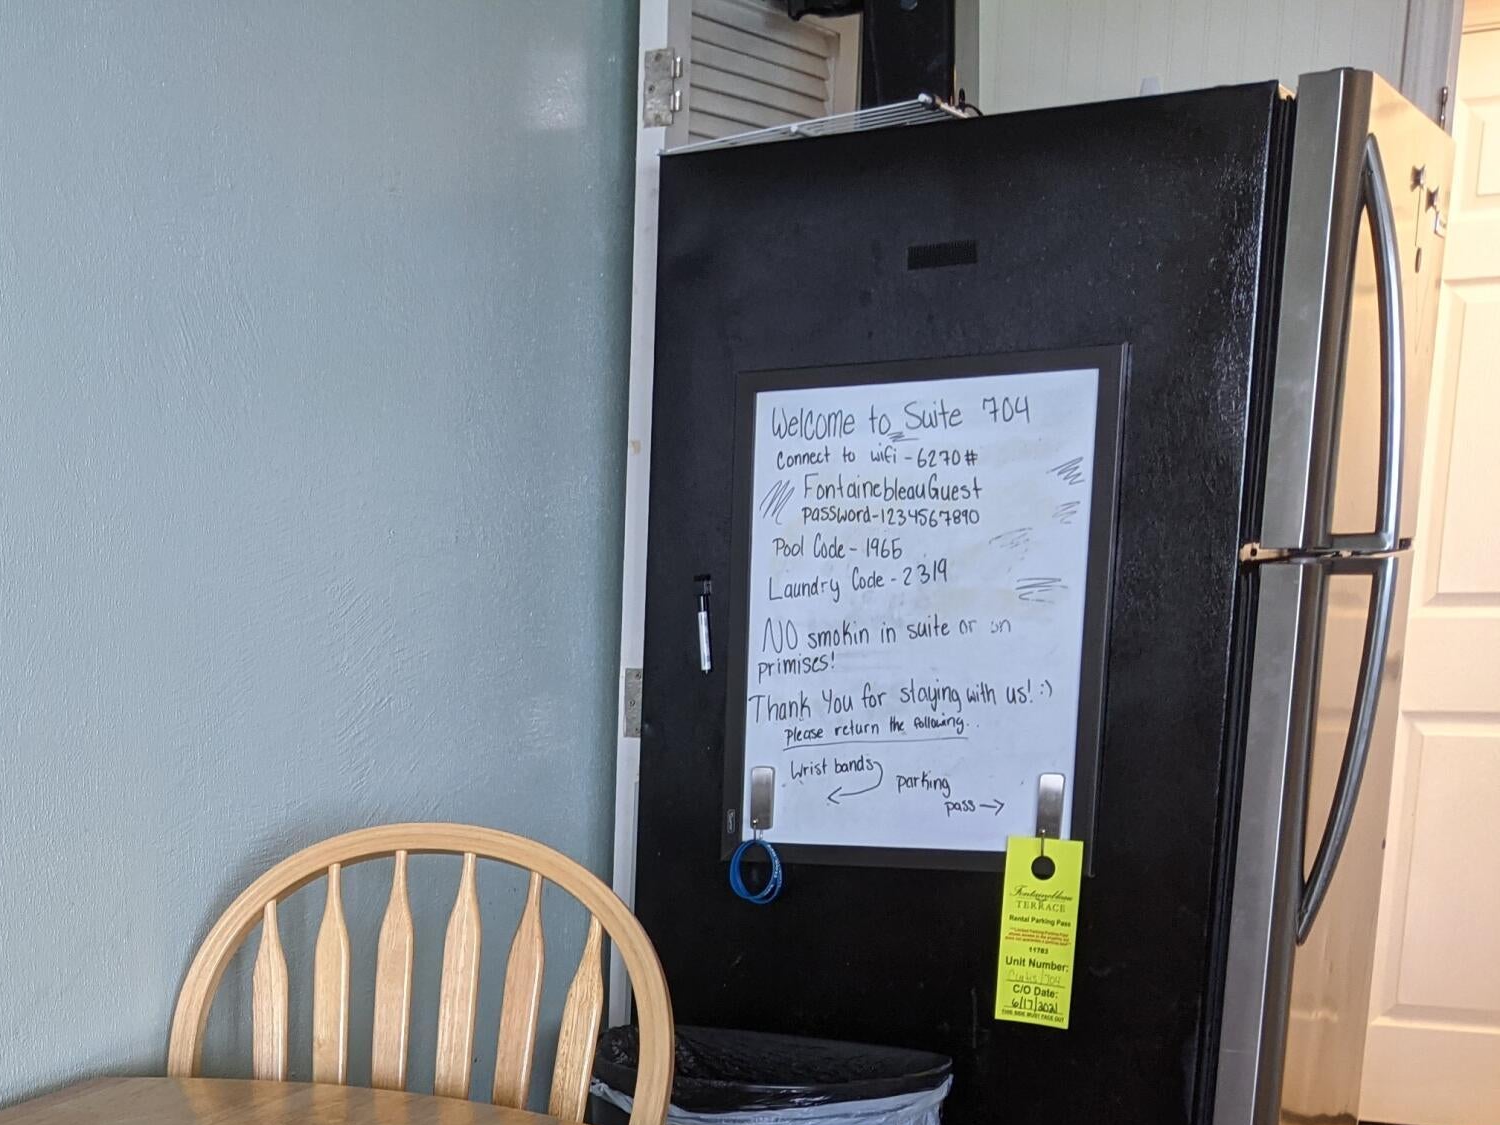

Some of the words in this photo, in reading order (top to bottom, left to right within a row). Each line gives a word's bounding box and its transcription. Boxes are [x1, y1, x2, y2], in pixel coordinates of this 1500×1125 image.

[772, 406, 855, 441] Welcome
[868, 405, 892, 435] to
[904, 399, 963, 430] Suite
[982, 395, 1030, 424] 704
[843, 446, 855, 462] to
[871, 445, 897, 463] wifi
[773, 536, 804, 558] Pool
[814, 534, 845, 559] Code
[769, 576, 840, 600] Laundry
[852, 568, 884, 590] Code
[903, 558, 947, 586] 2319
[762, 617, 798, 653] NO
[807, 619, 870, 648] smokin
[881, 621, 896, 644] in
[908, 613, 950, 640] suite
[959, 619, 975, 635] or
[758, 652, 835, 683] primises!
[748, 692, 811, 723] Thank
[862, 682, 887, 707] for
[900, 679, 962, 712] staying
[967, 680, 996, 705] with
[835, 719, 879, 736] return
[890, 715, 904, 733] the
[791, 757, 828, 779] Wrist
[835, 756, 874, 776] bands
[897, 770, 951, 797] parking
[946, 799, 975, 817] pass
[1016, 901, 1067, 913] TERRACE
[1030, 916, 1055, 926] Parking
[1056, 919, 1071, 928] Pass
[1005, 956, 1026, 967] Unit
[1028, 959, 1069, 973] Number:
[1012, 984, 1031, 995] C/O
[1034, 987, 1058, 999] Date:
